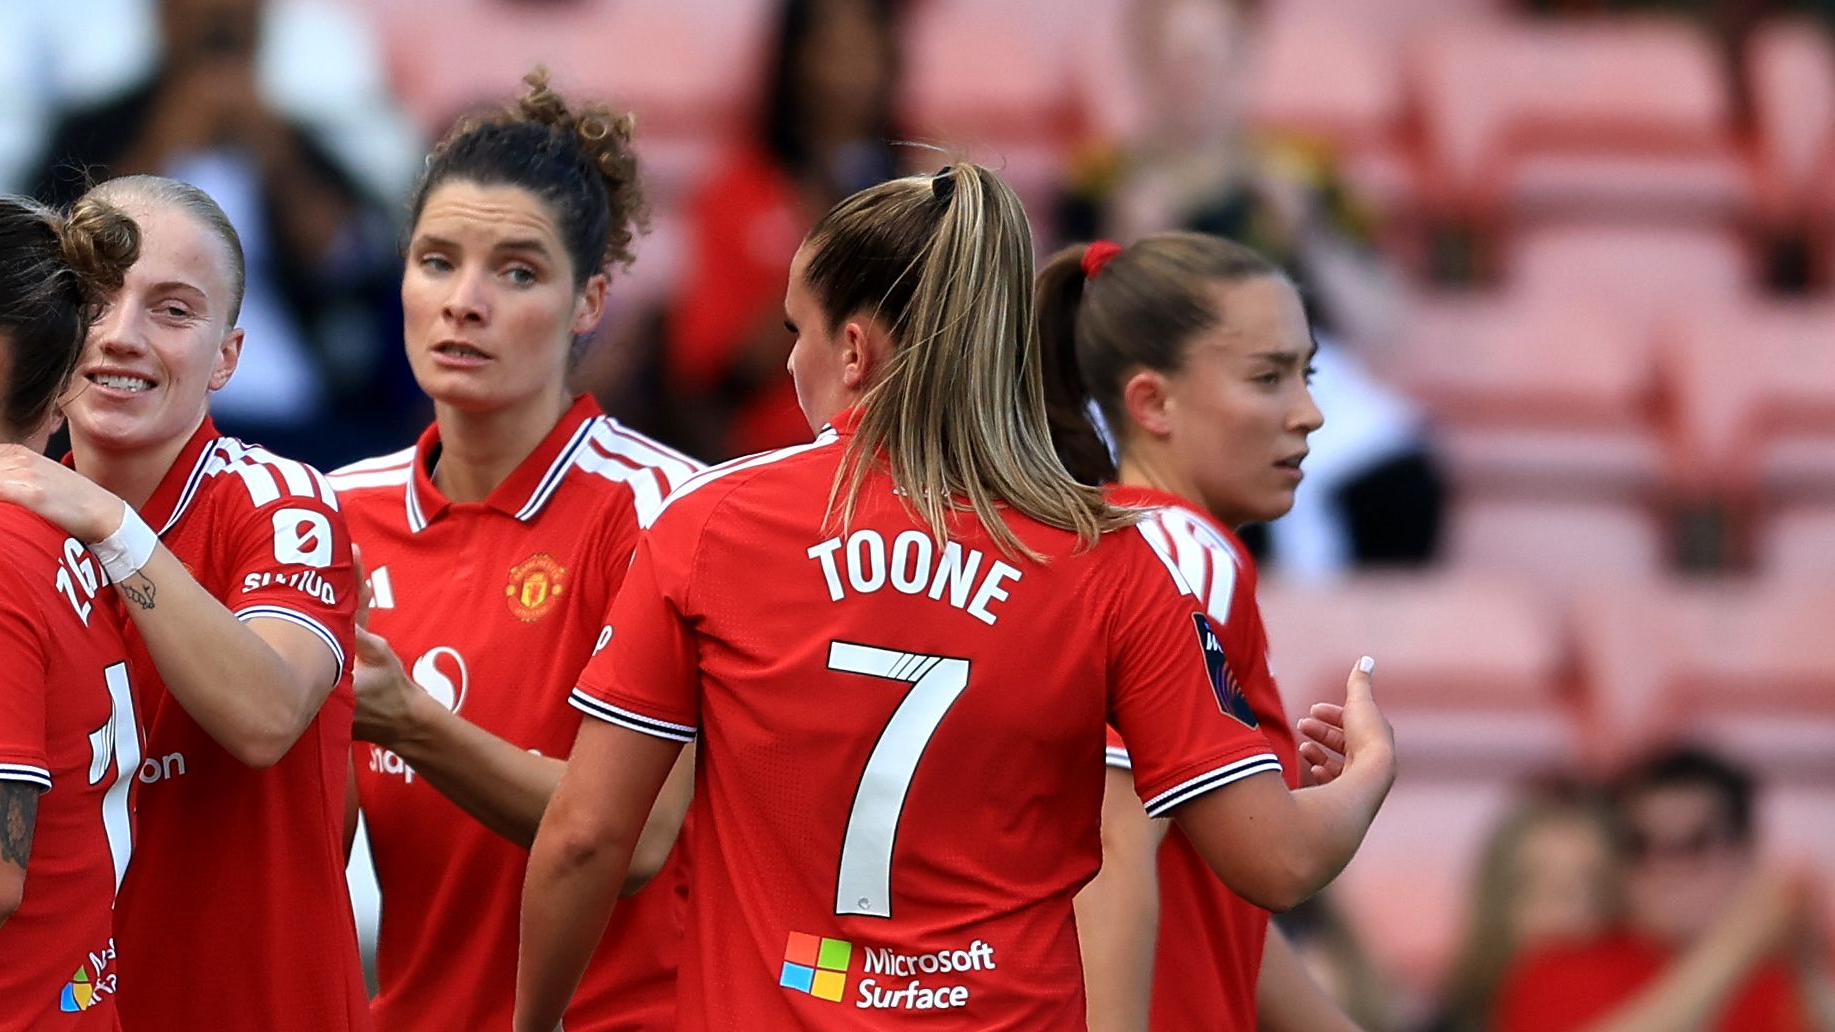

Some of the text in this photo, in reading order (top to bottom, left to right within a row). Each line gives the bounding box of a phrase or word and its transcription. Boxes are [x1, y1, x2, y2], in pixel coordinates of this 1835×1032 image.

[806, 528, 1023, 626] TOONE
[827, 640, 971, 918] 7
[863, 940, 997, 977] Microsoft
[856, 979, 969, 1010] Surface
